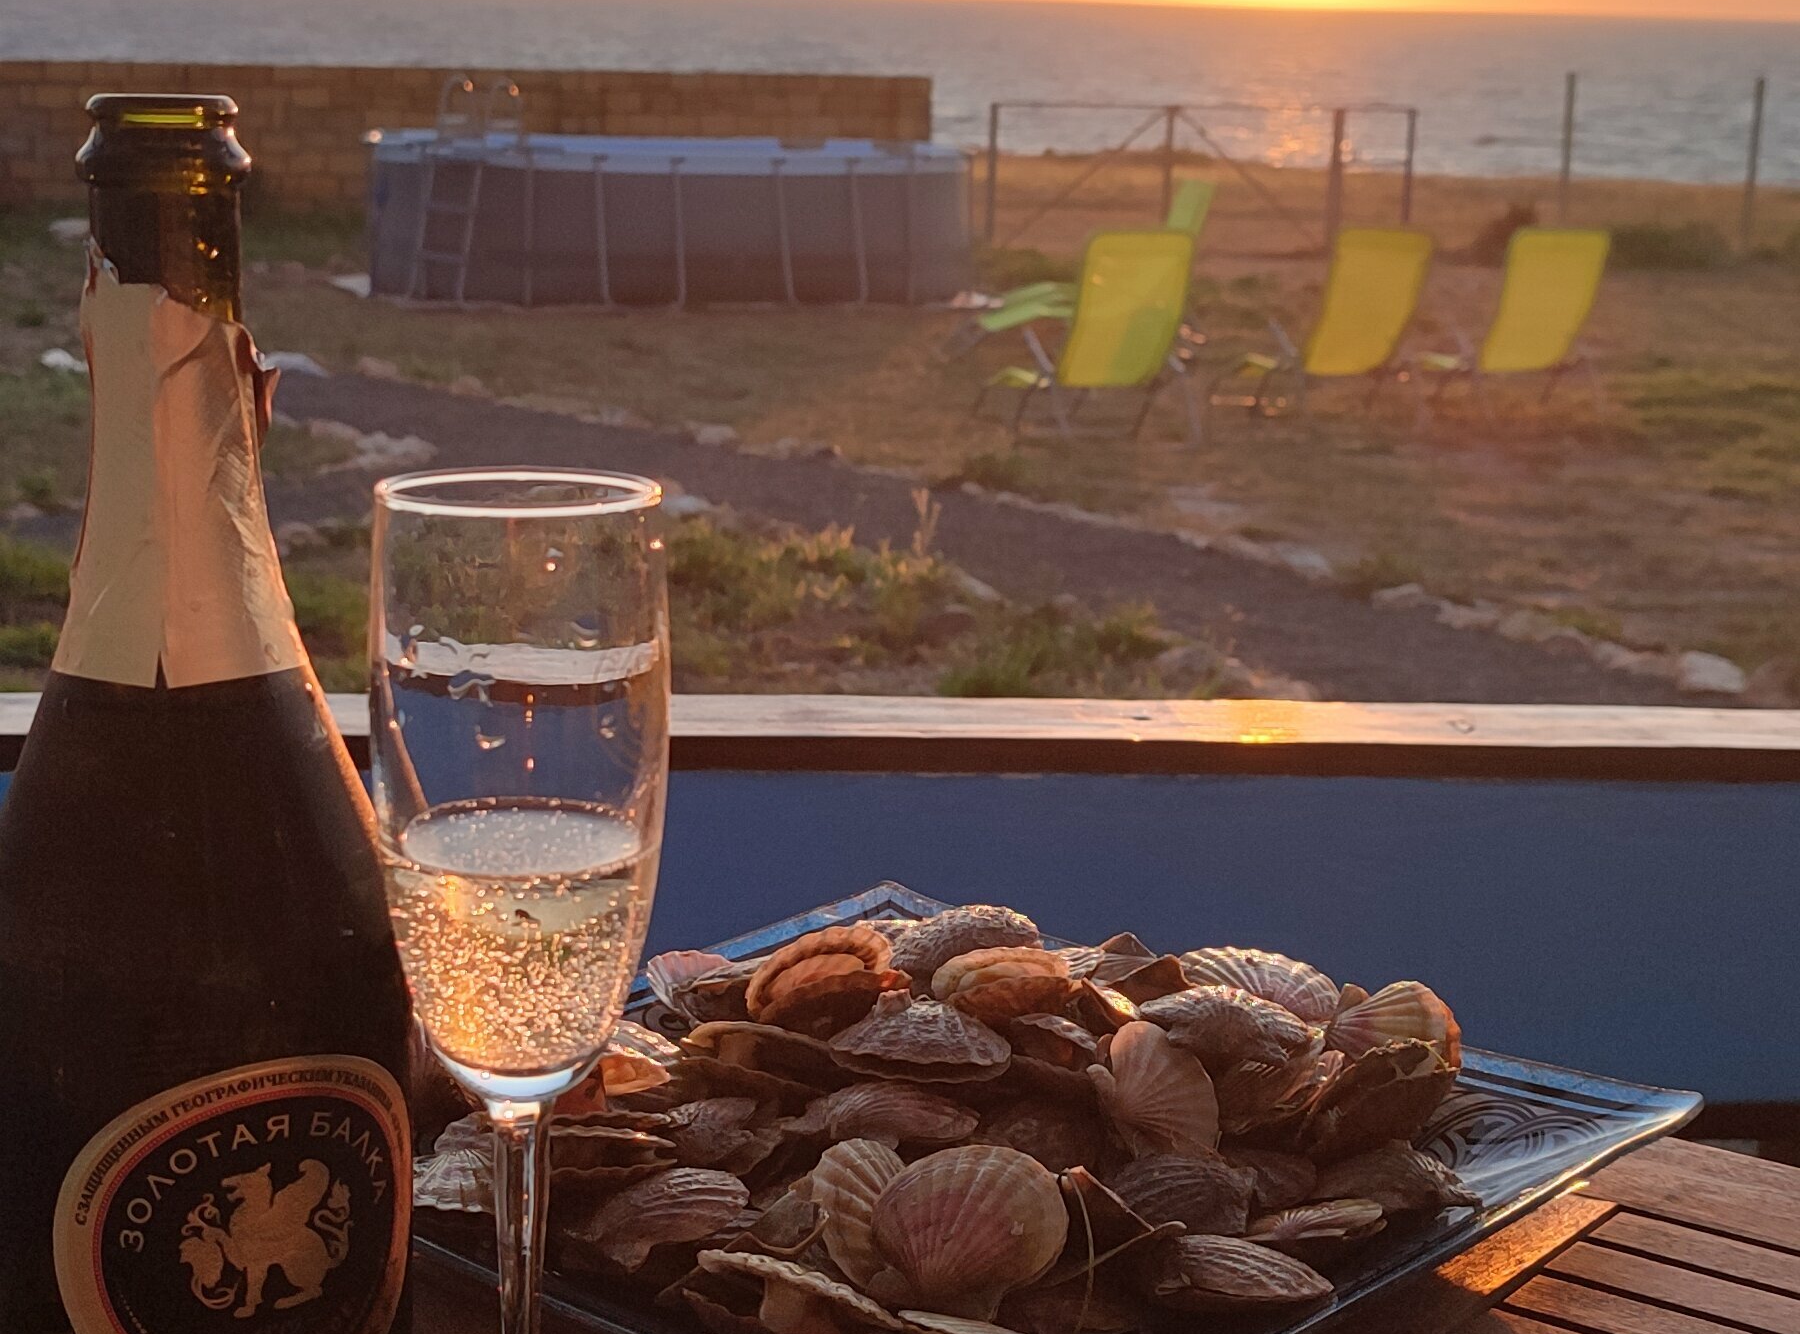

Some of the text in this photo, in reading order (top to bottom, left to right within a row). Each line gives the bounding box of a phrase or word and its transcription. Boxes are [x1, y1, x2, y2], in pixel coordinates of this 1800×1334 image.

[170, 1069, 333, 1118] ГЕОГРАФИЧЕСКИМ
[119, 1111, 388, 1254] ЗОЛОТАЯ БАЛКА
